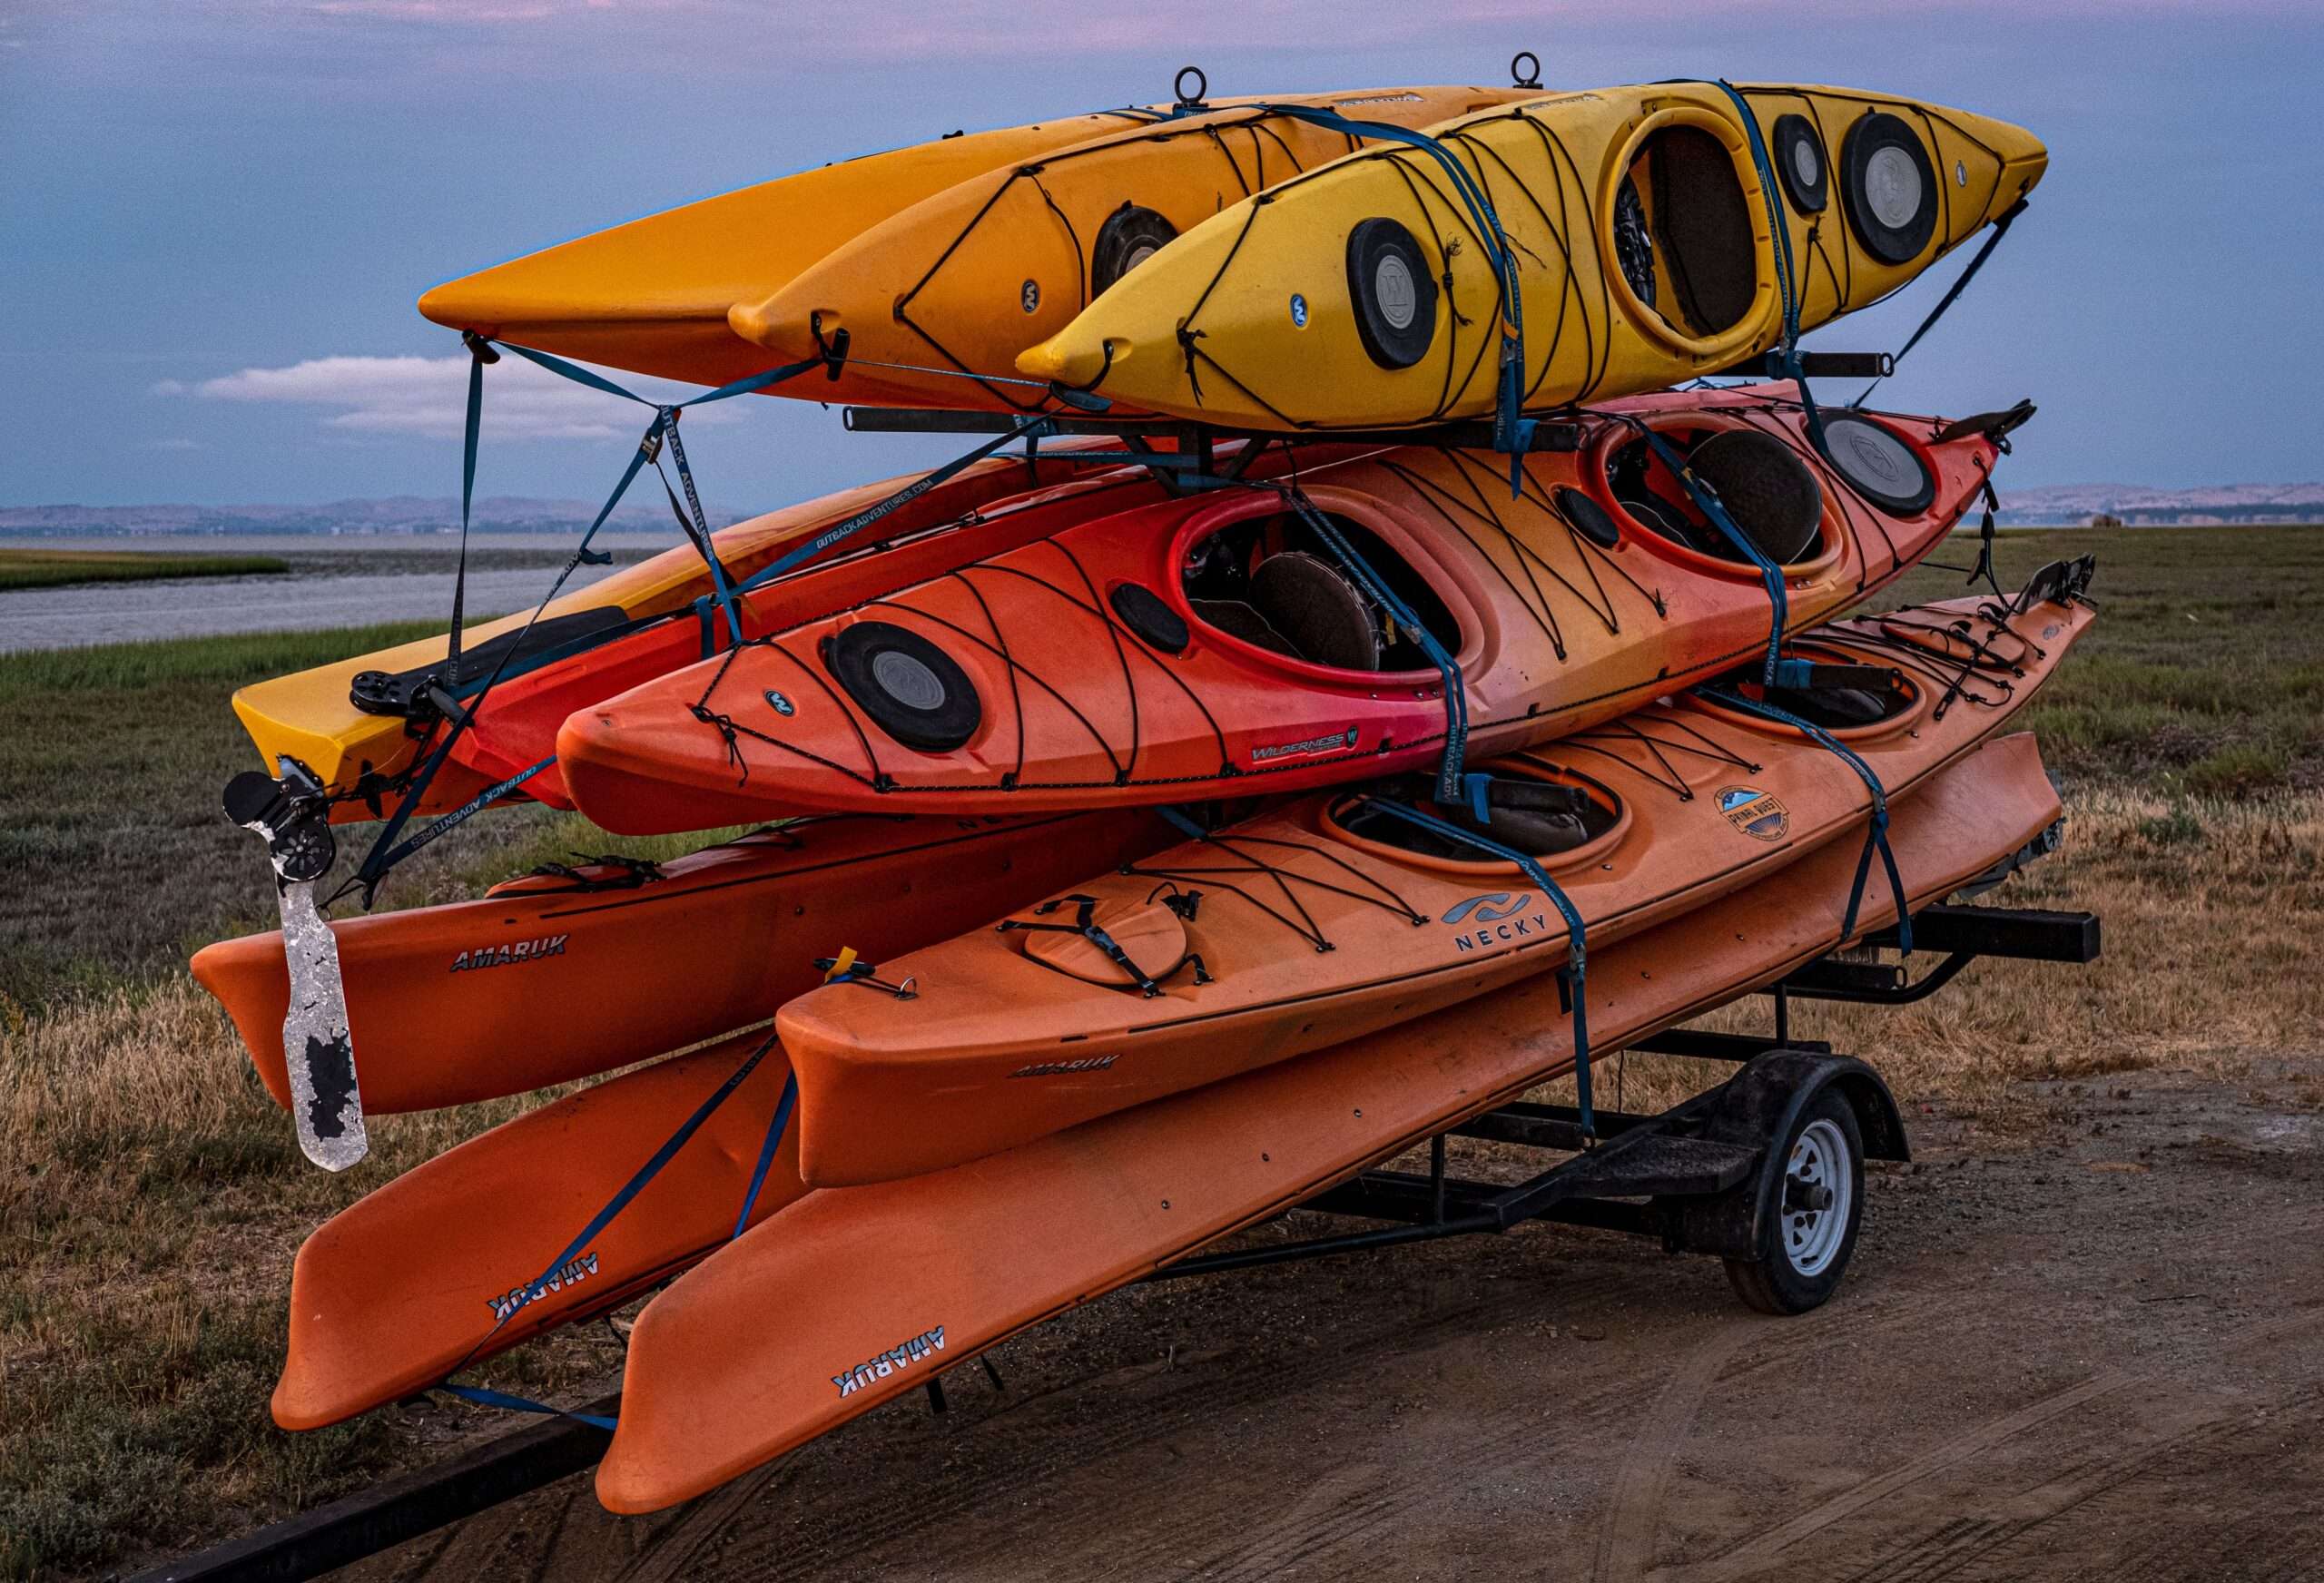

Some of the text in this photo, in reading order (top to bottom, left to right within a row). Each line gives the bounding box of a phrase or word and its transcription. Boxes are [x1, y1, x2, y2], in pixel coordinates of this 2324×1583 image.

[681, 472, 714, 561] ADVENTURES
[817, 478, 934, 549] OUTBACKADVENTURES.COM
[1253, 733, 1344, 760] WILDERNESS
[410, 766, 537, 849] OUTBACK ADVENTURES
[450, 933, 569, 971] AMARUK
[1454, 914, 1547, 952] NECKY
[1007, 1054, 1123, 1077] AMARUK
[487, 1253, 599, 1320] AMARUK
[831, 1325, 945, 1398] AMARUK
